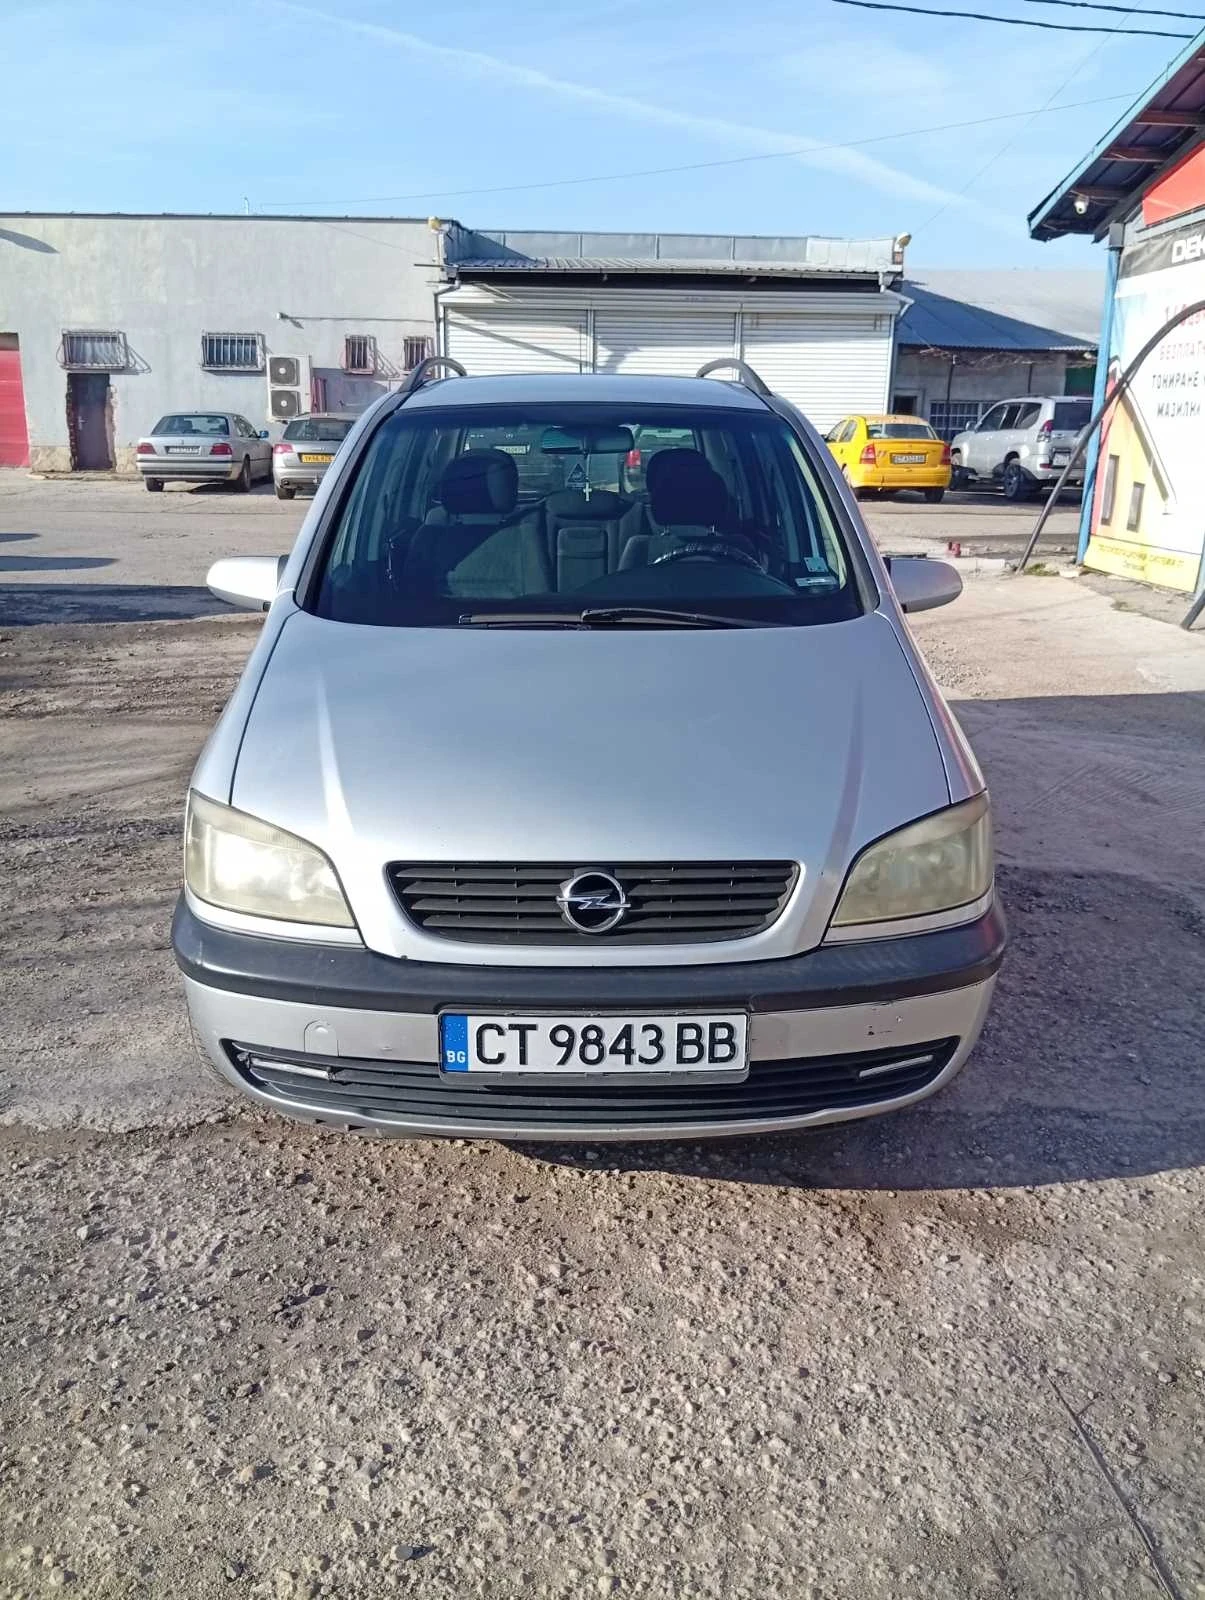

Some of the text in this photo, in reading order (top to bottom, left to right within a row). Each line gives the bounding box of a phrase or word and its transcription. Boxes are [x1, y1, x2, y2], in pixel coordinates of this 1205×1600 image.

[1152, 371, 1199, 389] ТОНИРАНЕ
[475, 1021, 737, 1066] CT 9843 BB
[446, 1050, 466, 1063] BG
